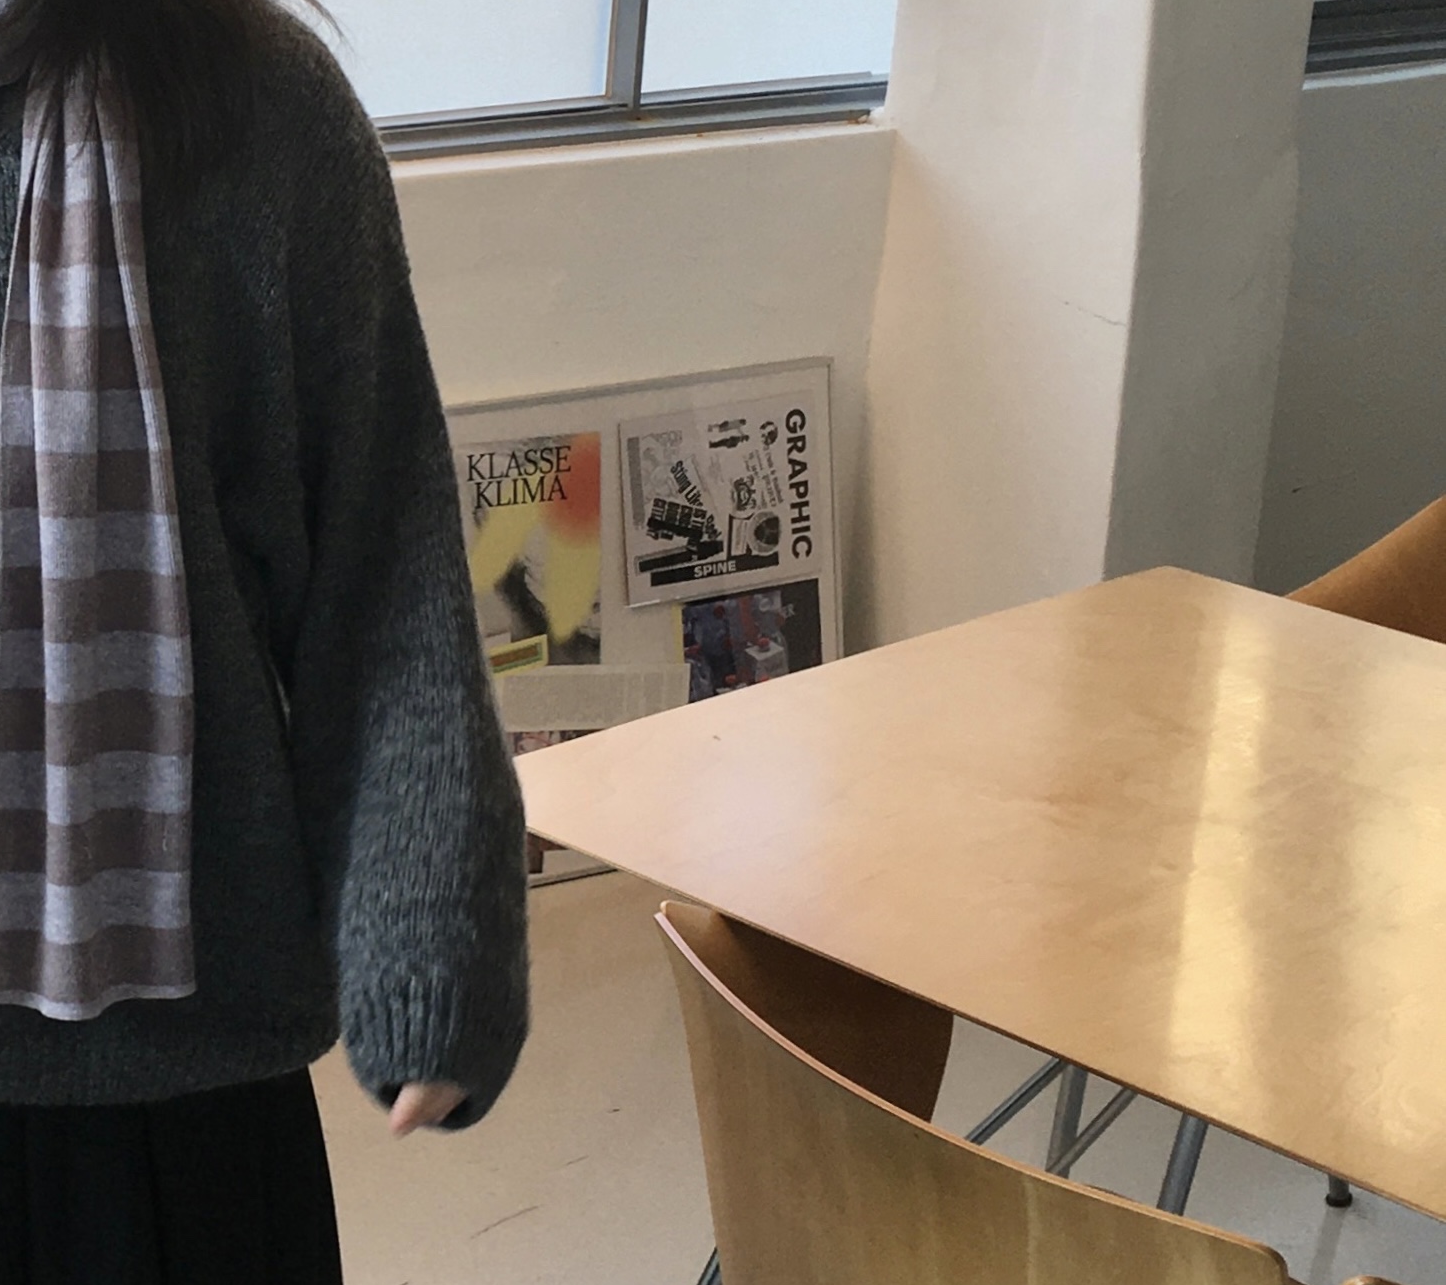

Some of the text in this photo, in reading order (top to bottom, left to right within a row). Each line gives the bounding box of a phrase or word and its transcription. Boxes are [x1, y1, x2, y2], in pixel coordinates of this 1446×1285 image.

[467, 445, 572, 482] KLASSE
[474, 474, 568, 510] KLIMA
[785, 408, 812, 560] GRAPHIC
[693, 560, 738, 579] SPINE
